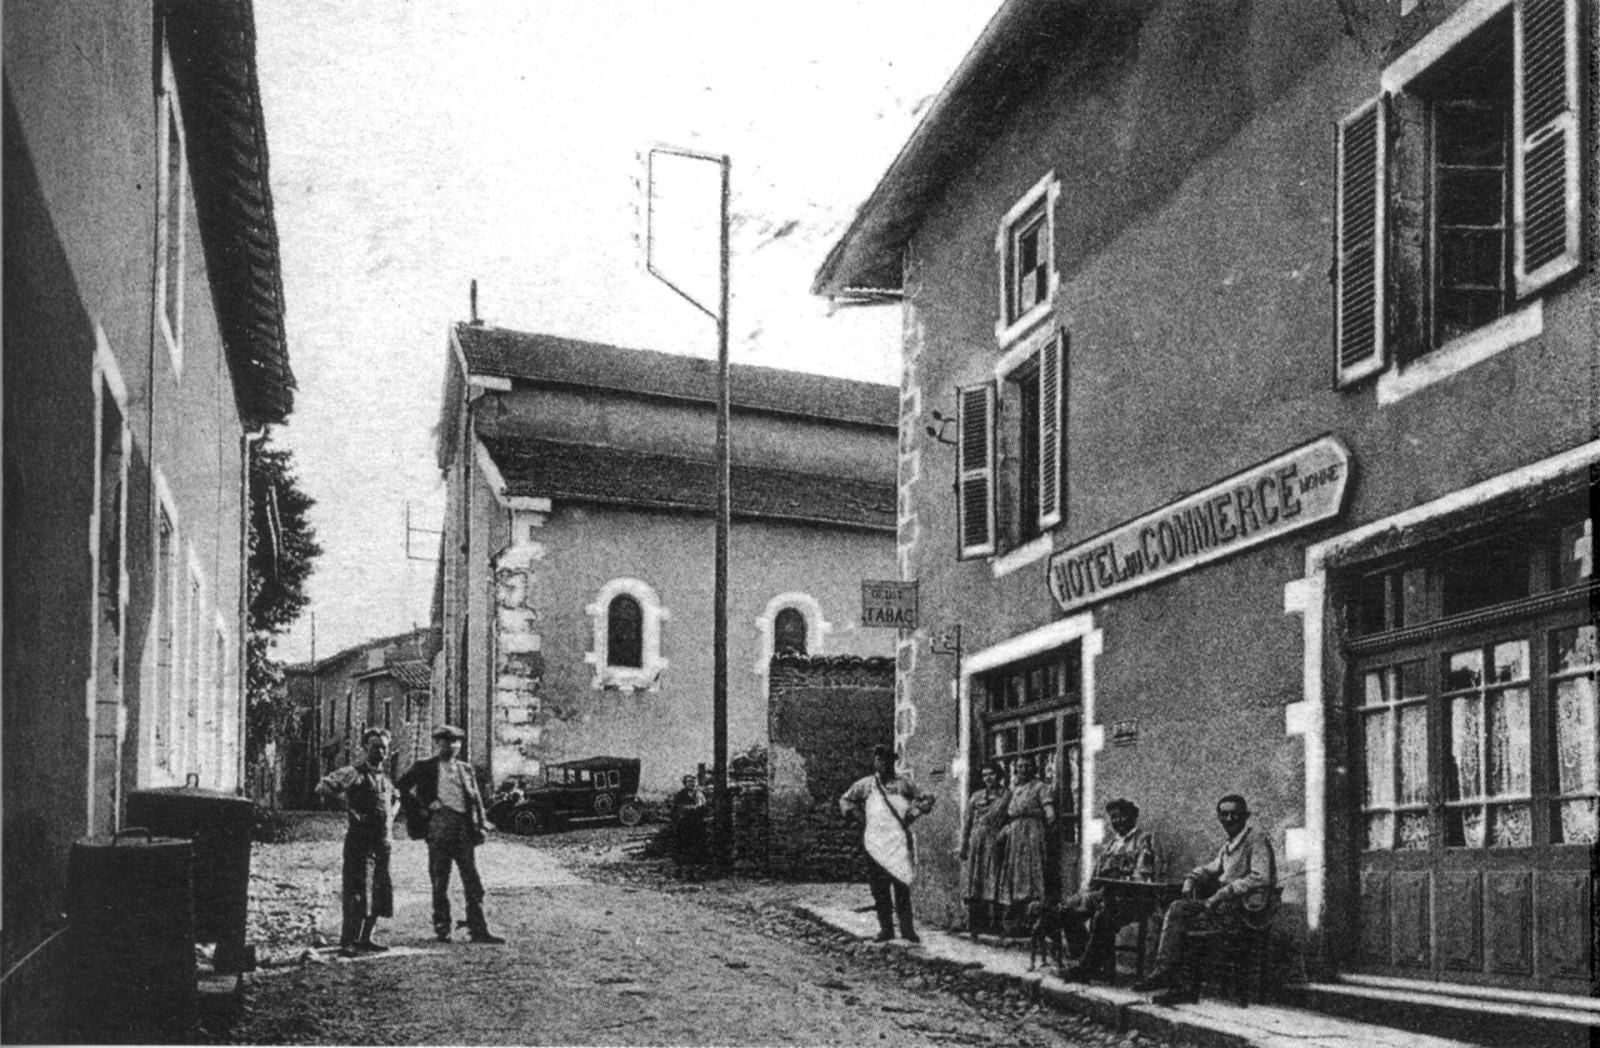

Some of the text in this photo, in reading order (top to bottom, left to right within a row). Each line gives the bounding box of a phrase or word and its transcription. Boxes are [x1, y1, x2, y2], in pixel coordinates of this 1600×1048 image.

[1054, 541, 1128, 602] HOTEL
[1140, 462, 1302, 570] COMMERCE
[865, 607, 914, 623] TABAC
